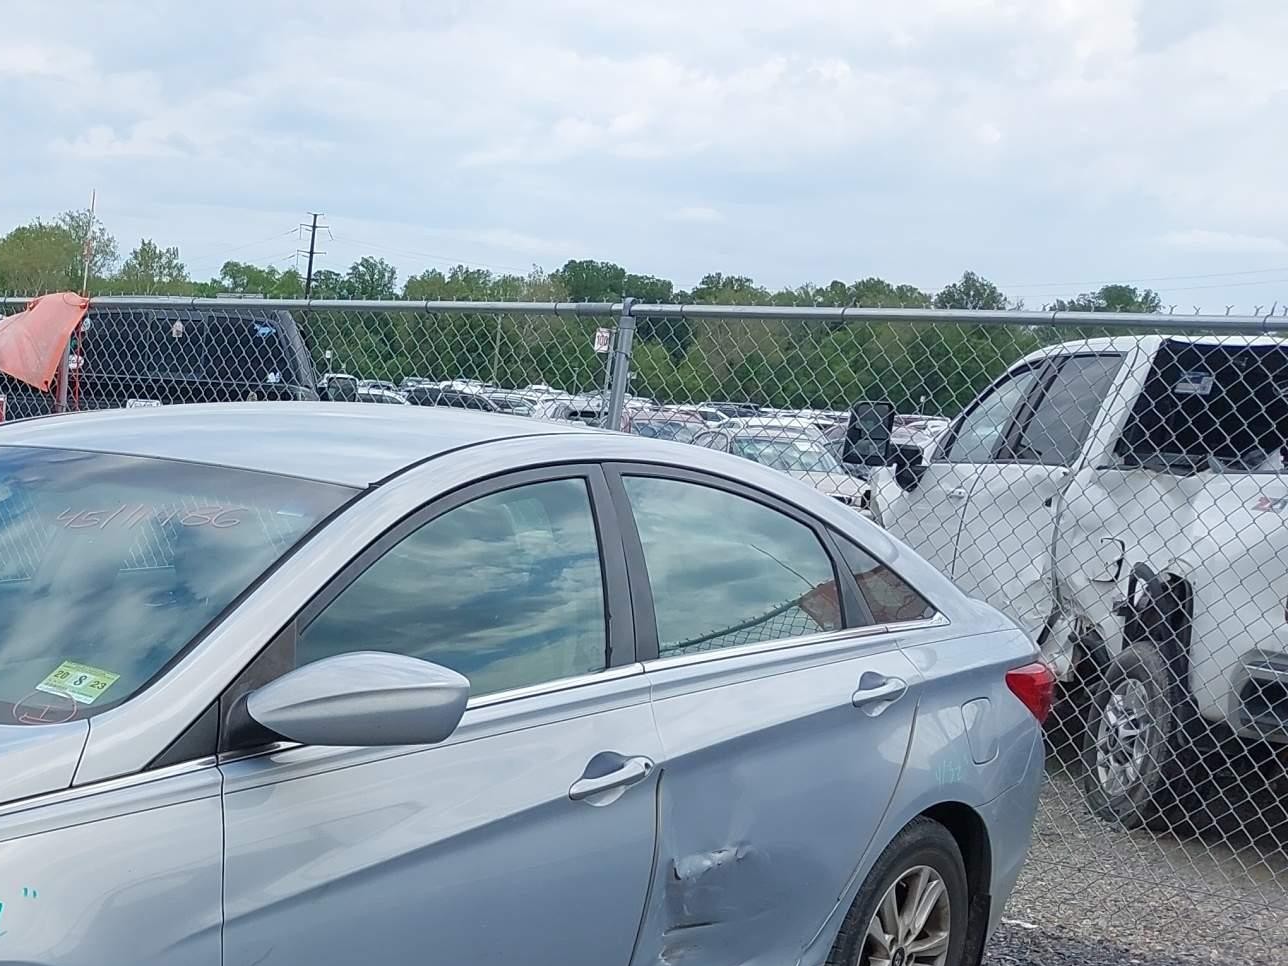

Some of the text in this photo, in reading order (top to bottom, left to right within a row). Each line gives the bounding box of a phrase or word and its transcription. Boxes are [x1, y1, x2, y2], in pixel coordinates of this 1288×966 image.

[54, 670, 70, 680] 20
[73, 675, 88, 686] 8
[90, 680, 107, 690] 23
